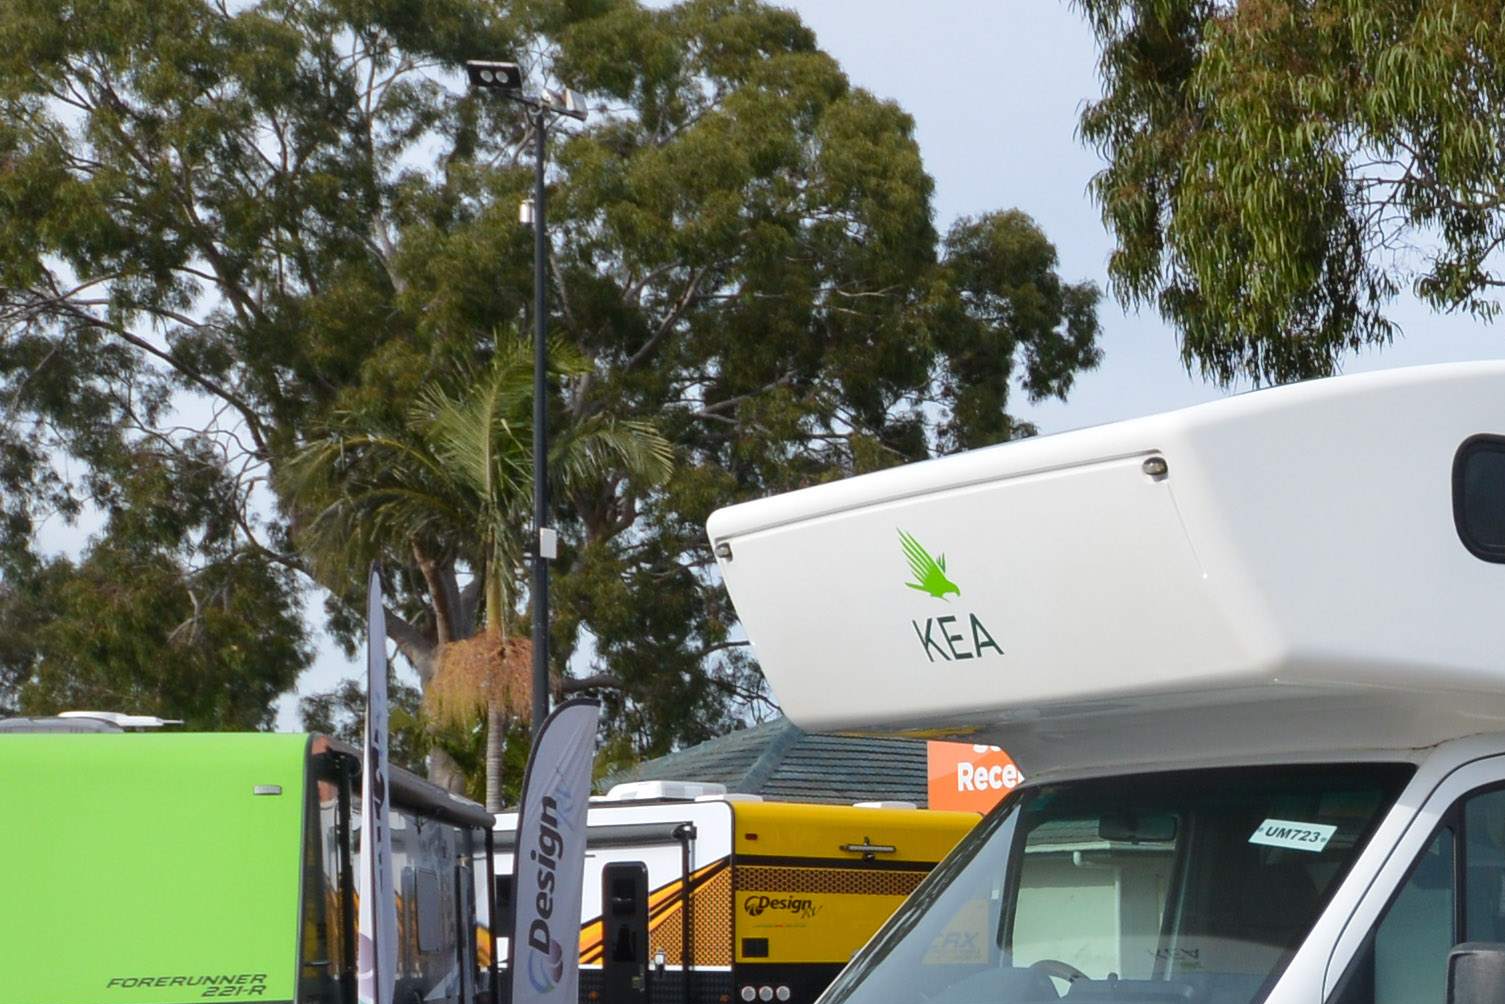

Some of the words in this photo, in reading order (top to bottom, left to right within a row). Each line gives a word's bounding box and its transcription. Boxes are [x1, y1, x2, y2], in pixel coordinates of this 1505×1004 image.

[911, 612, 1005, 663] KEA
[1264, 825, 1322, 843] UM723
[527, 795, 564, 955] Design
[758, 895, 812, 914] Design
[106, 973, 268, 989] FORERUNNER
